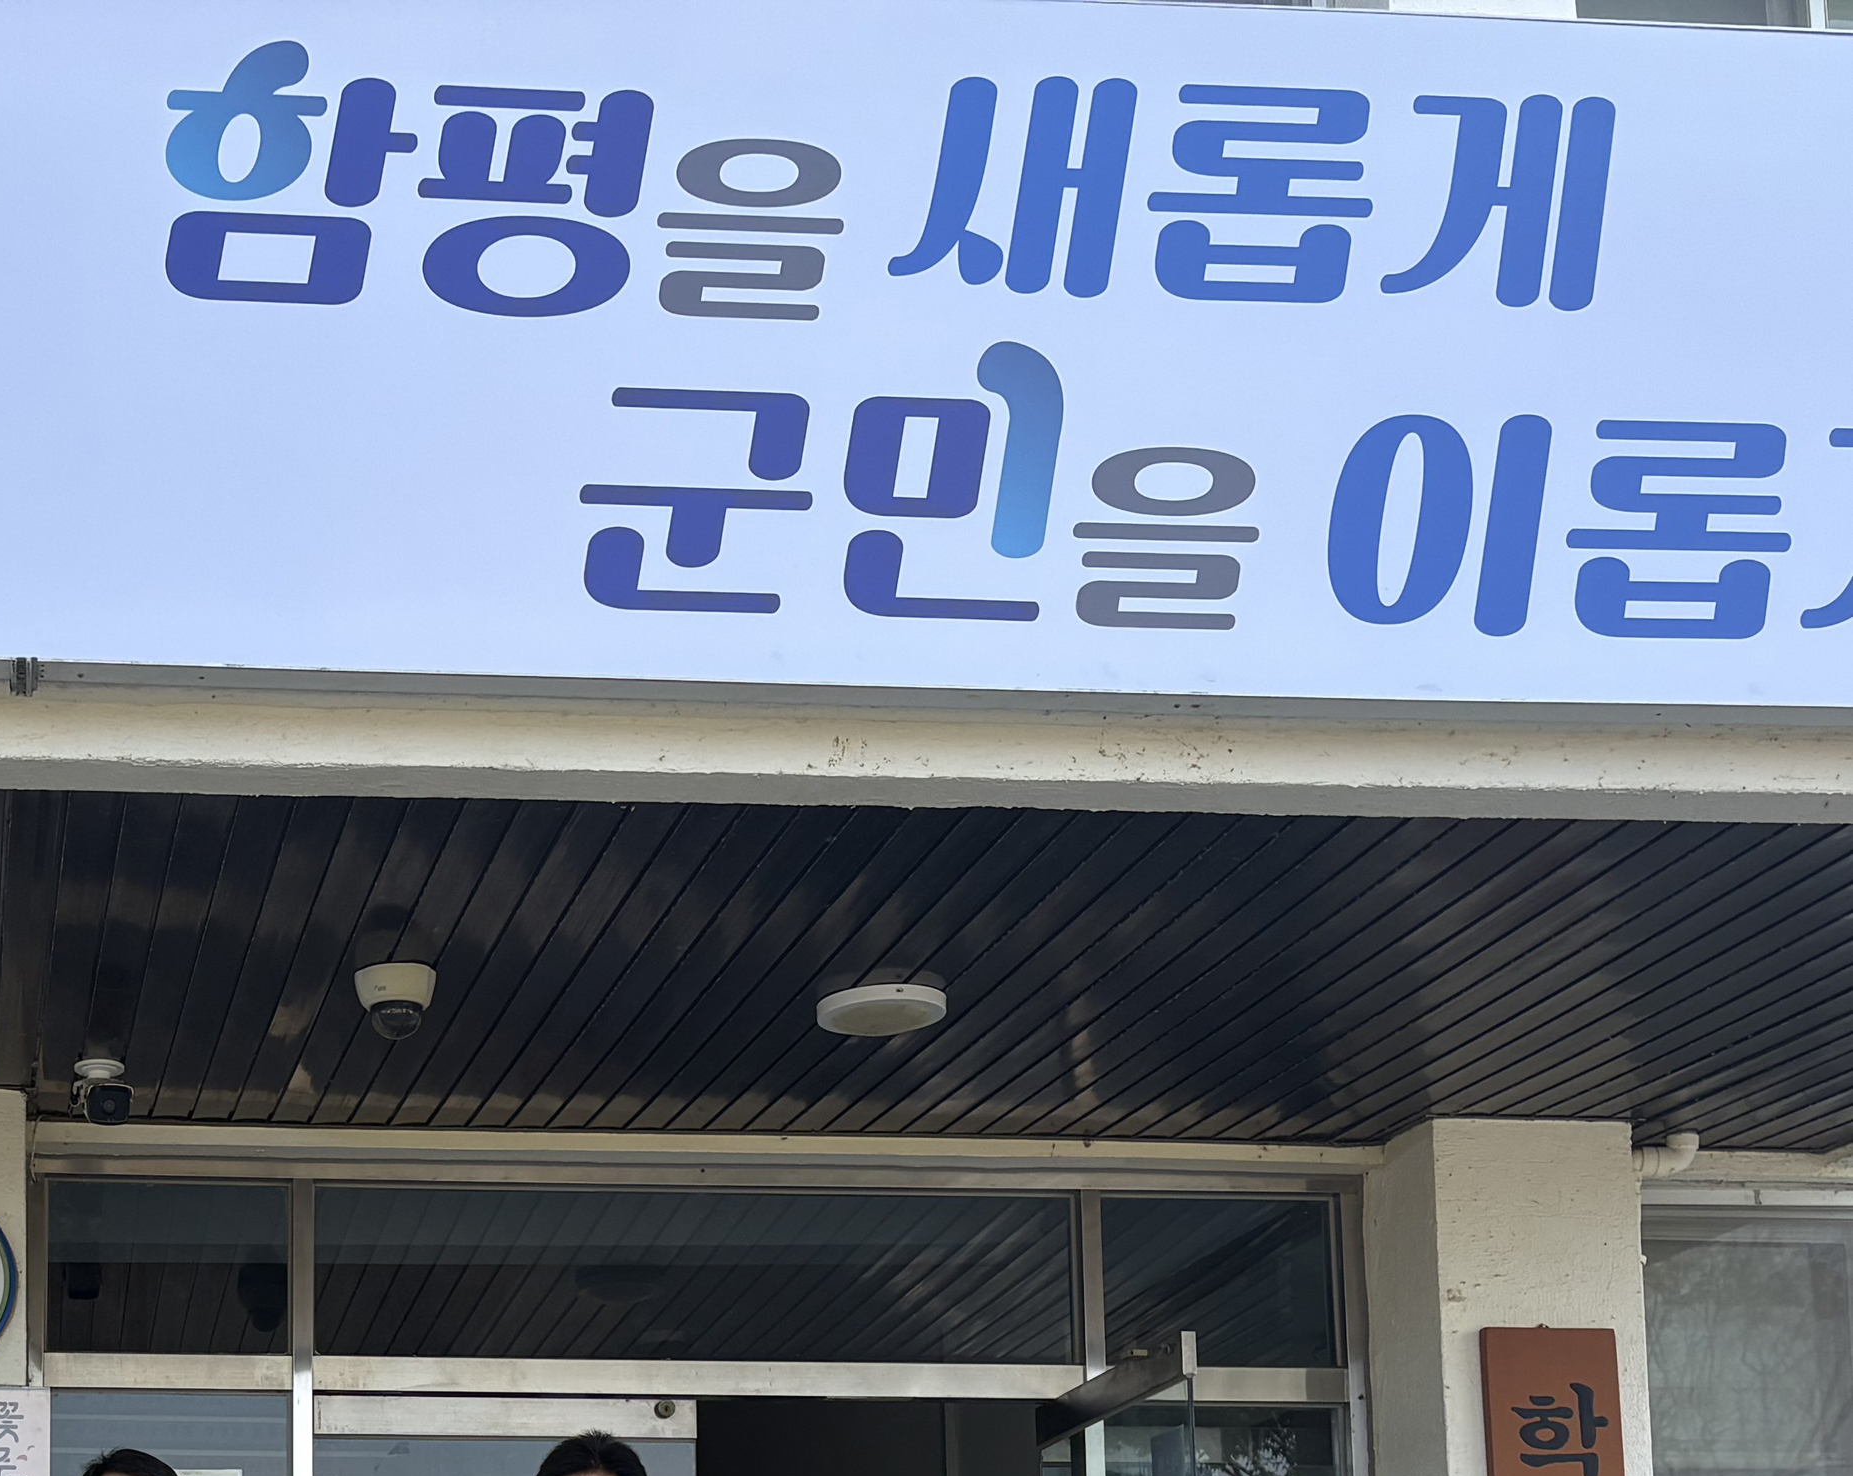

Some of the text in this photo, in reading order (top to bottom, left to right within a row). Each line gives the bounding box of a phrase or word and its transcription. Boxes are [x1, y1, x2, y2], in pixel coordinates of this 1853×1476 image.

[163, 38, 1617, 321] 함평을 새롭게
[579, 339, 1260, 632] 군민을
